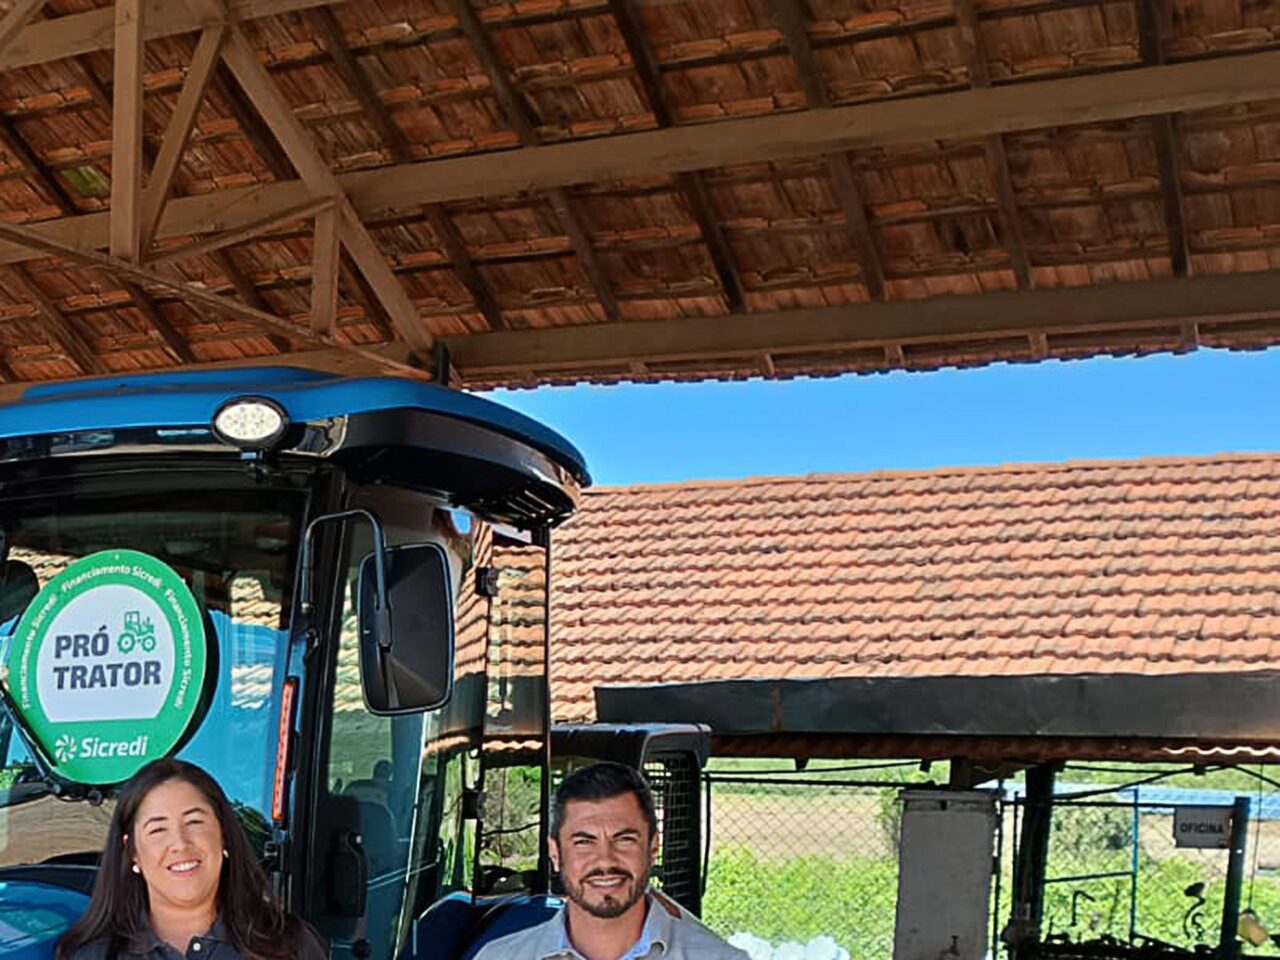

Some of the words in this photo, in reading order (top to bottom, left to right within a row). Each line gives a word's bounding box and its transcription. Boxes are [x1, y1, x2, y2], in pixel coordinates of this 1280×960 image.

[61, 565, 131, 593] Financiamento
[131, 565, 163, 590] Sicredi
[54, 625, 110, 659] PRÓ
[53, 660, 161, 690] TRATOR
[80, 735, 148, 758] Sicredi
